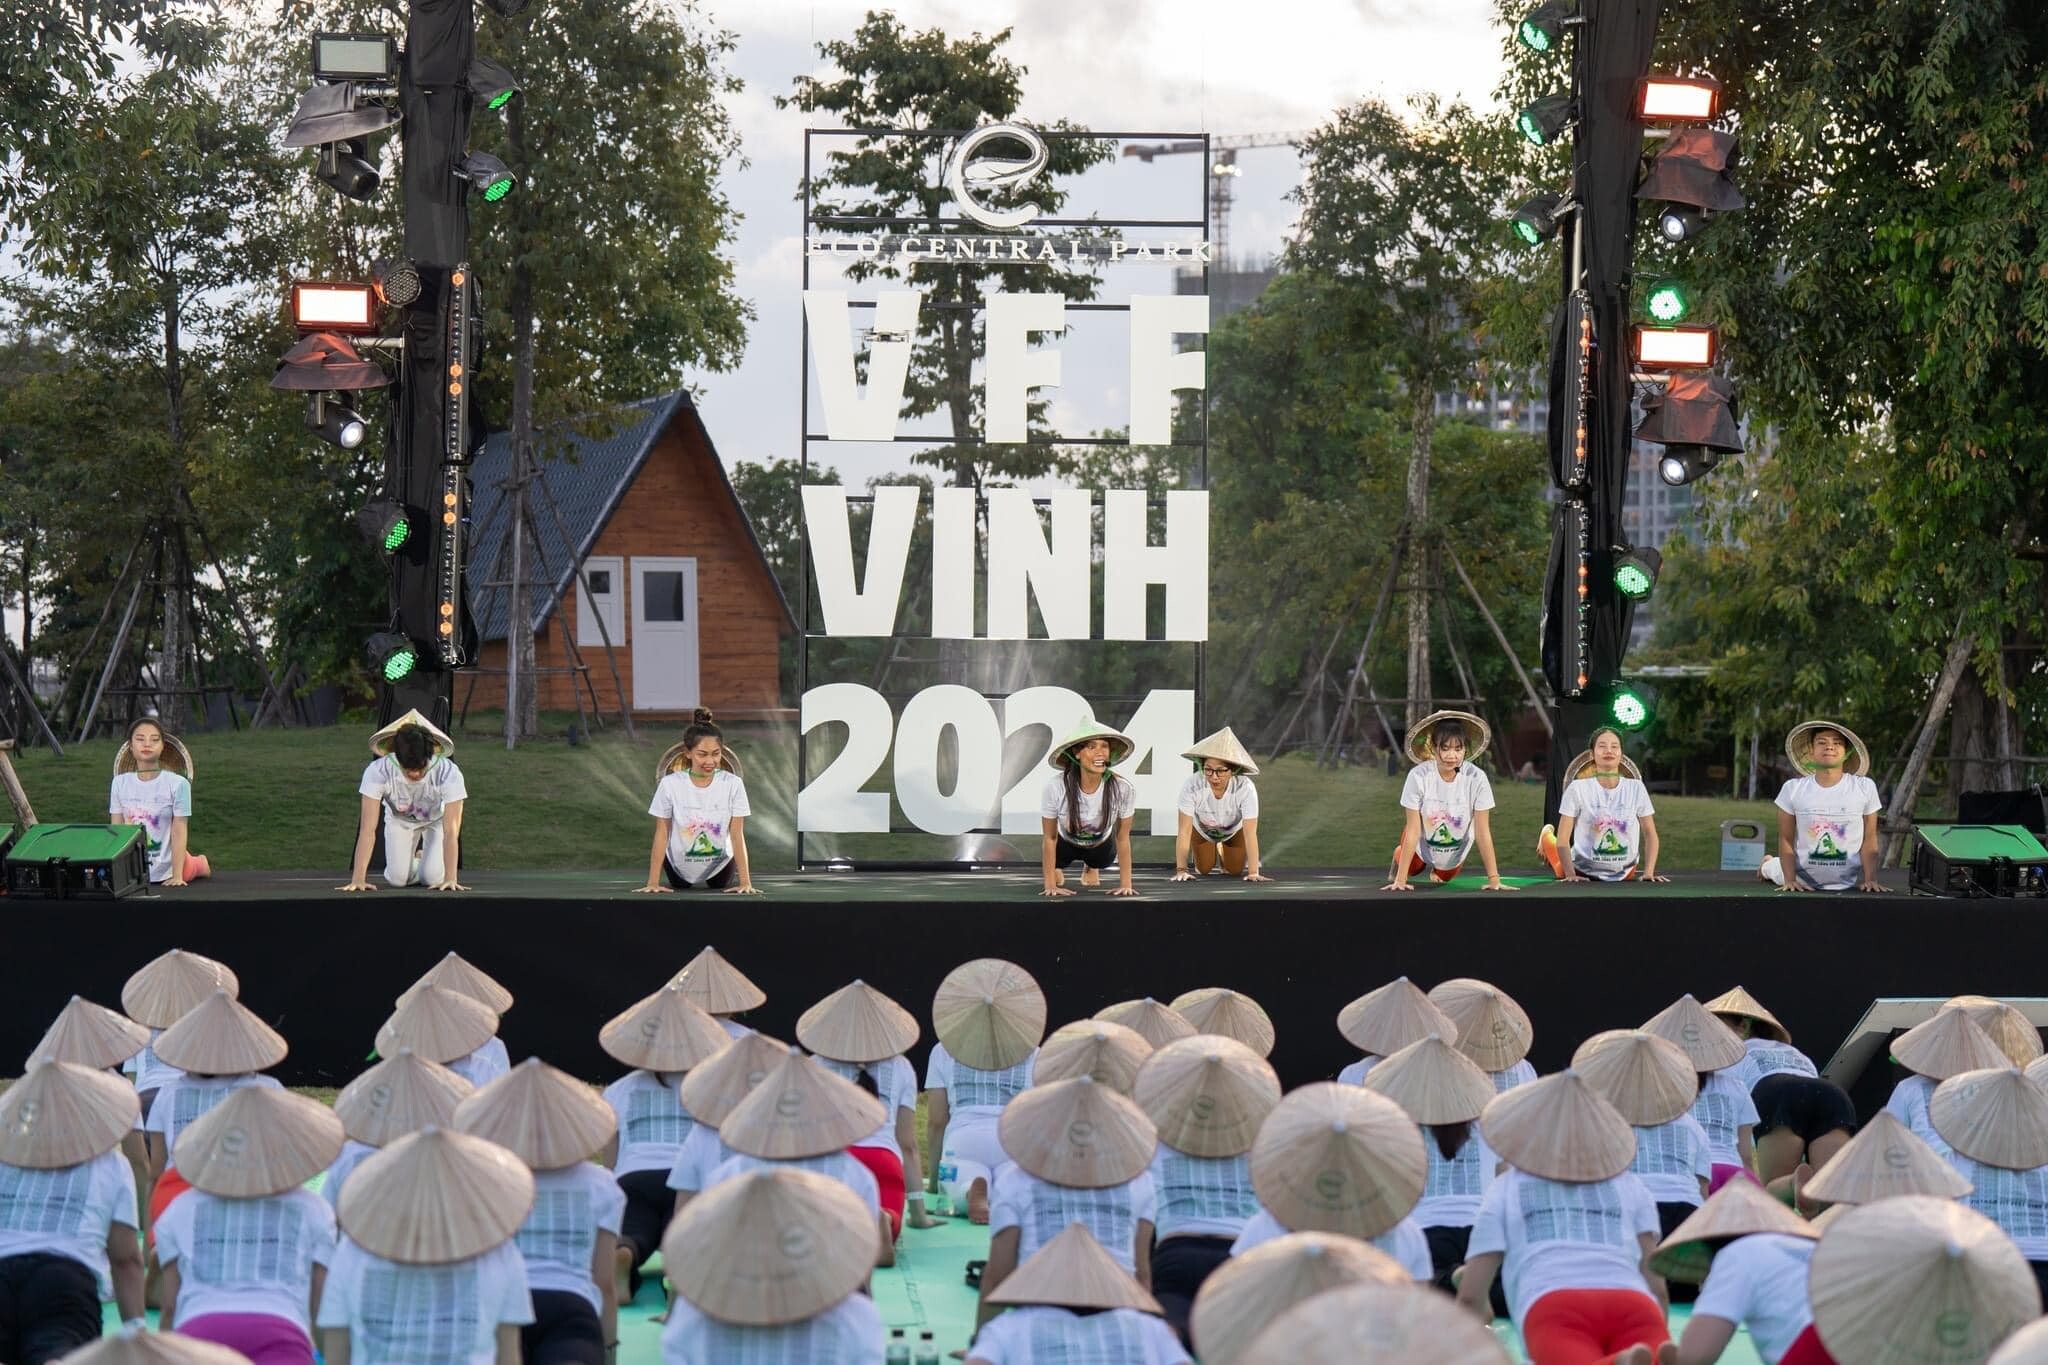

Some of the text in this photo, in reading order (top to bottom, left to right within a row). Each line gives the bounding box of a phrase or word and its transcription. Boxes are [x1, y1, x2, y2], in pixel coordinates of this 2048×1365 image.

[806, 236, 1212, 262] ECO CENTRAL PARK
[802, 290, 1209, 445] VFF
[801, 485, 1209, 641] VINH
[797, 683, 1195, 836] 2024
